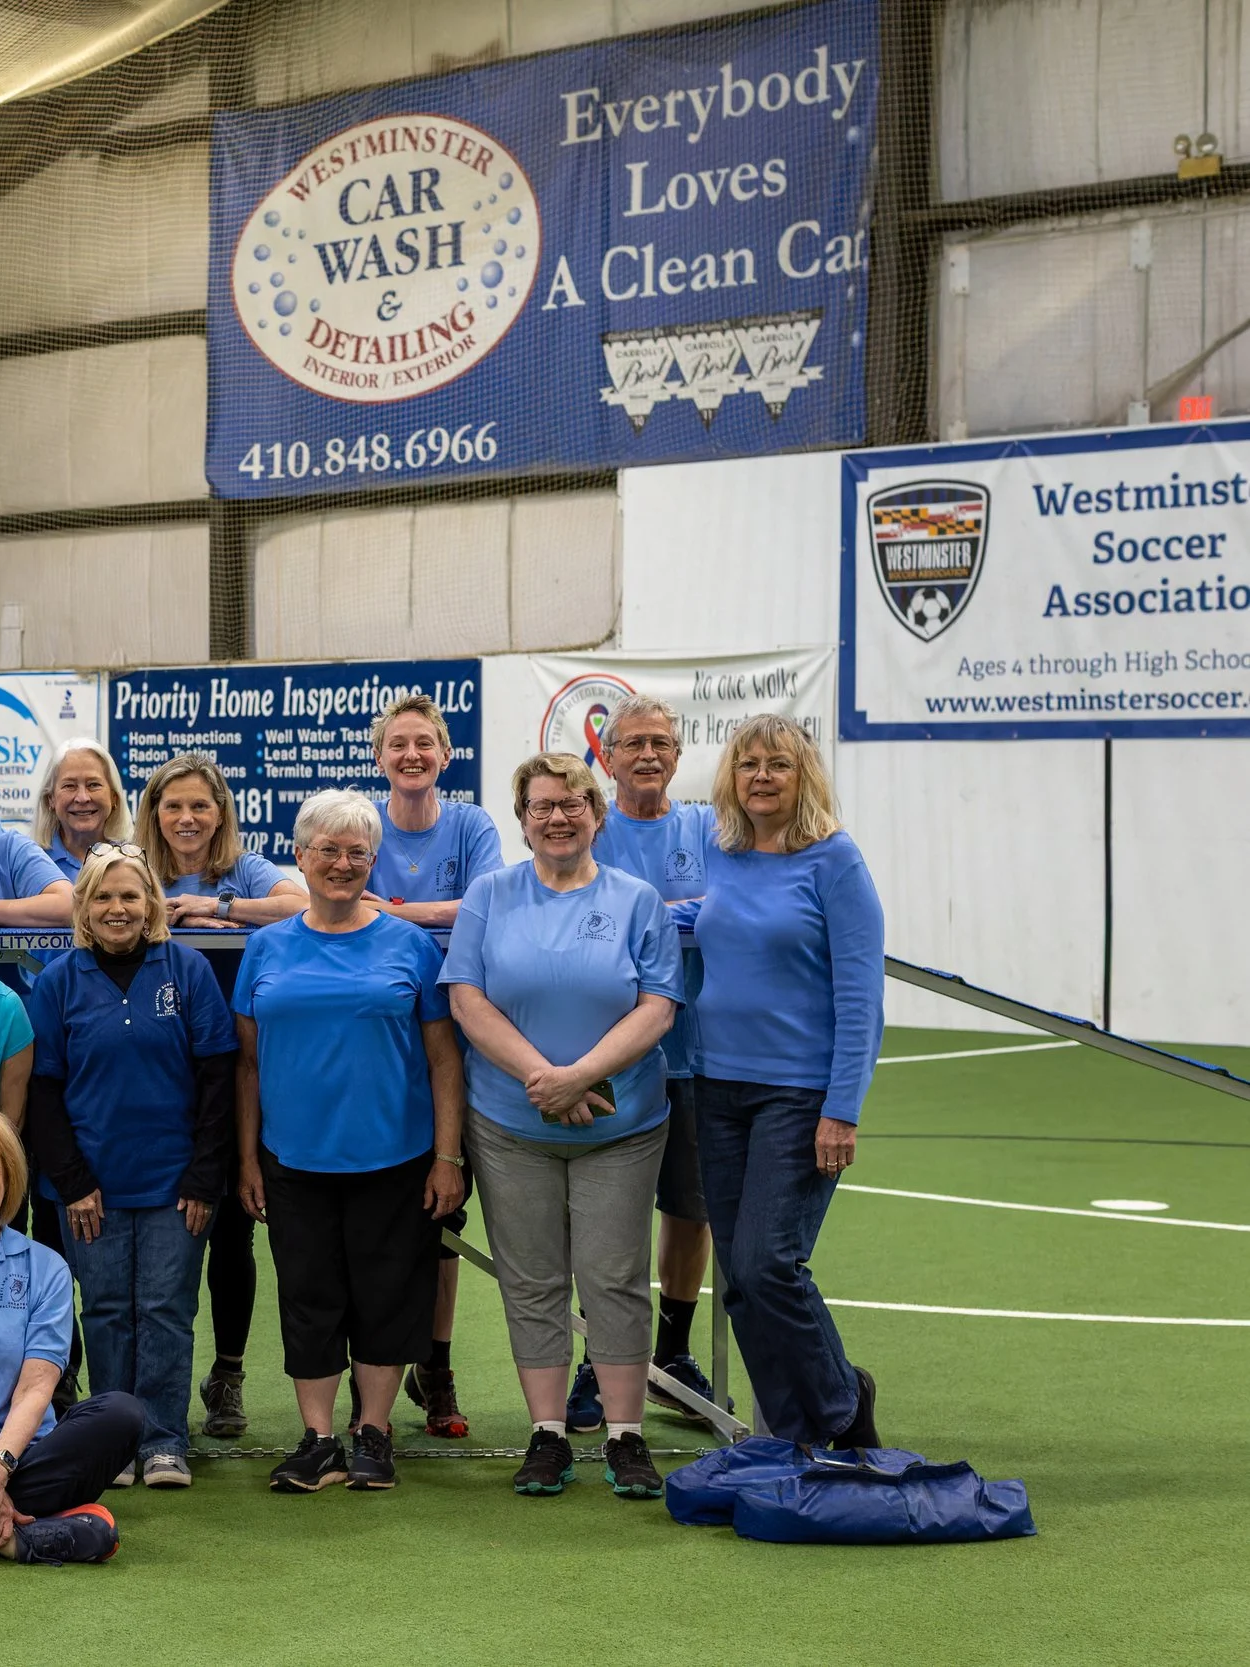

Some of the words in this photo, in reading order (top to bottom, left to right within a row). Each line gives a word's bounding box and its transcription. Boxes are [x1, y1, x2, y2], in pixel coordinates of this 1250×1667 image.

[560, 45, 866, 146] Everybody
[286, 126, 495, 203] WESTMINSTER
[338, 167, 446, 226] CAR
[622, 158, 788, 217] Loves
[314, 220, 466, 285] WASH
[541, 254, 586, 311] A
[601, 244, 758, 301] Clean
[376, 290, 403, 322] &
[305, 301, 476, 366] DETAILING
[302, 355, 379, 390] INTERIOR
[392, 333, 477, 387] EXTERIOR
[238, 421, 498, 481] 410.848.6966
[1032, 471, 1250, 517] Westminst
[884, 541, 972, 571] WESTMINSTER
[1092, 530, 1227, 565] Soccer
[1042, 574, 1250, 618] Associatio
[956, 655, 1007, 682] Ages
[1012, 662, 1024, 677] 4
[1029, 651, 1117, 679] through
[1124, 650, 1179, 678] High
[692, 670, 713, 701] No
[752, 668, 799, 700] walks
[925, 687, 1250, 714] www.westminstersoccer.
[114, 680, 200, 727] Priority
[209, 678, 275, 719] Home
[435, 679, 475, 714] LLC
[129, 731, 165, 746] Home
[168, 730, 243, 748] Inspections
[264, 729, 294, 744] Well
[297, 728, 337, 744] Water
[339, 727, 373, 743] Testi
[682, 713, 700, 745] he
[706, 713, 750, 745] Hea
[129, 748, 168, 762] Radon
[264, 746, 298, 761] Lead
[301, 745, 344, 761] Based
[349, 745, 375, 760] Pai
[129, 764, 161, 782] Sept
[264, 763, 313, 778] Termite
[317, 762, 385, 780] Inspectio
